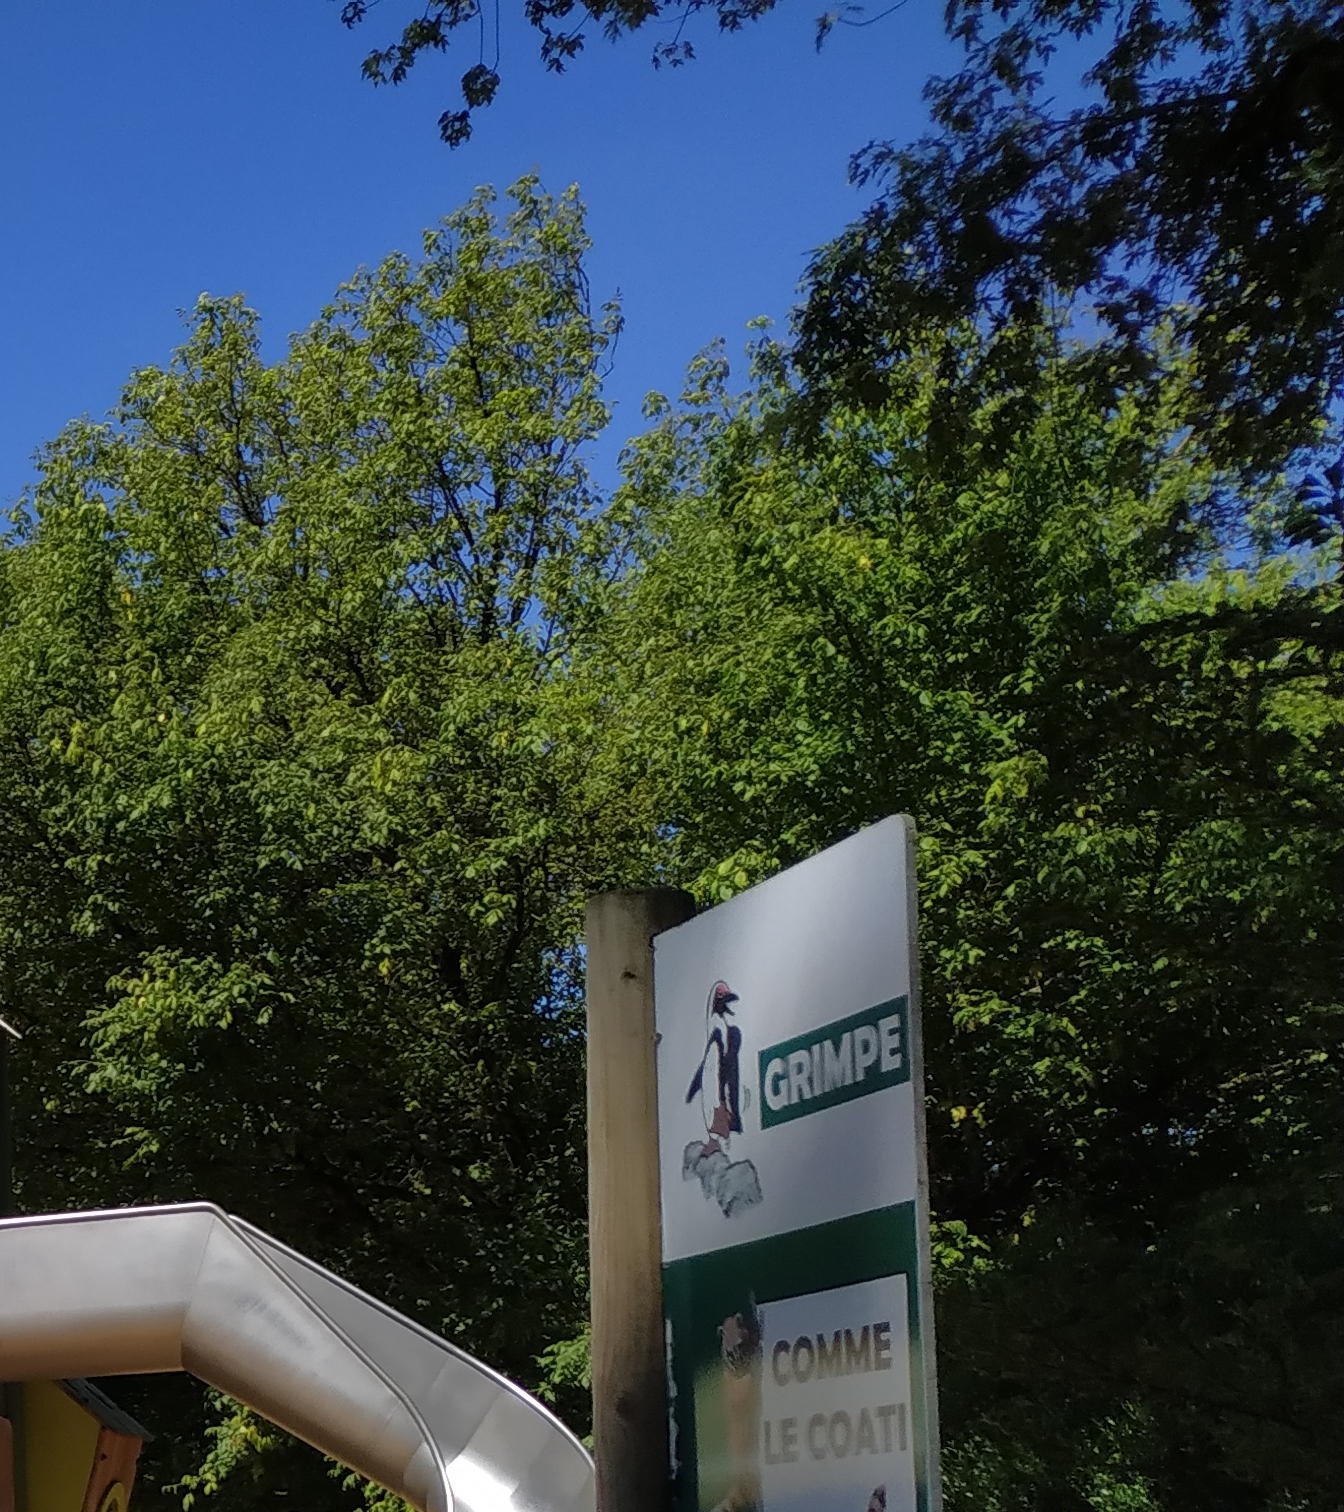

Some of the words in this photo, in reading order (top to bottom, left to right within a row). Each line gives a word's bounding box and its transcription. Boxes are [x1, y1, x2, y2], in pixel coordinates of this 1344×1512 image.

[765, 1014, 902, 1110] GRIMPE
[772, 1321, 892, 1386] COMME
[764, 1417, 798, 1464] LE
[808, 1402, 907, 1460] COATI
